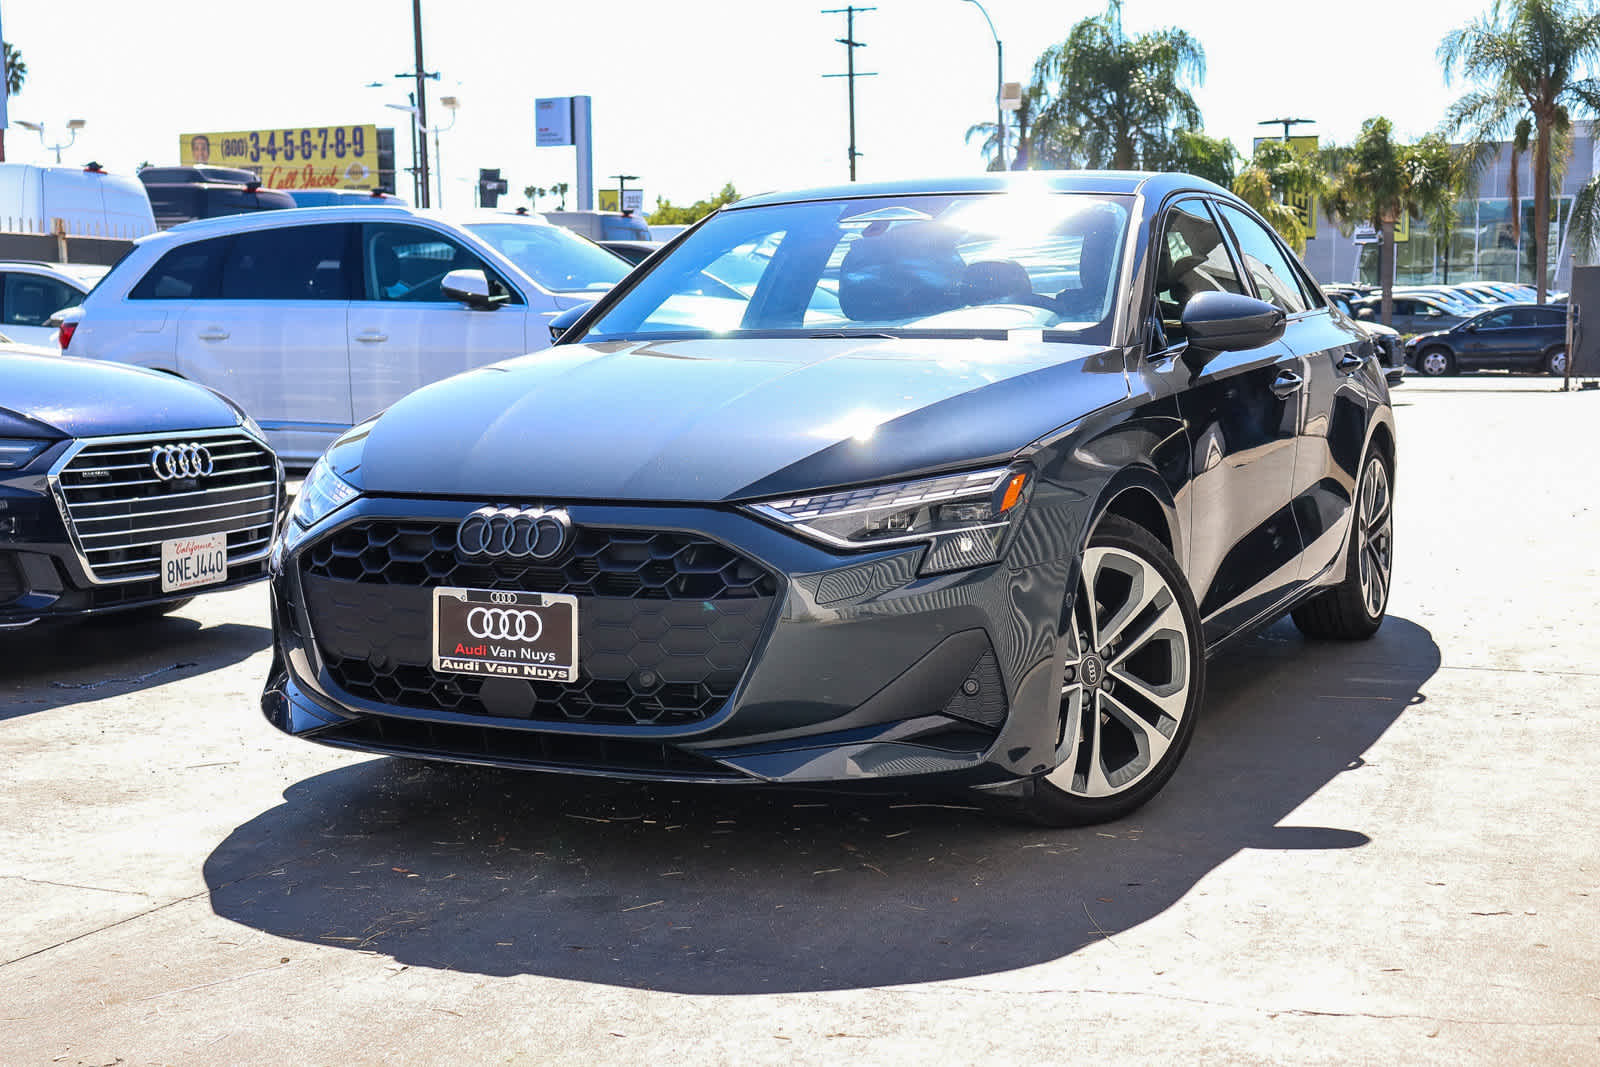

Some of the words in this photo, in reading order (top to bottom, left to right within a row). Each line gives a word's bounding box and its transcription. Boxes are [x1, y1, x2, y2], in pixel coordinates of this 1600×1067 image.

[221, 138, 248, 160] (800)
[250, 126, 364, 162] 3-4-5-6-7-8-9
[267, 166, 298, 189] Call
[300, 163, 340, 189] Jacob
[167, 550, 223, 583] 8NEJ440
[454, 643, 487, 656] Audi
[490, 645, 517, 658] Van
[520, 648, 556, 663] Nuys
[441, 659, 480, 671] Audi
[485, 662, 518, 674] Van
[523, 665, 568, 680] Nuys
